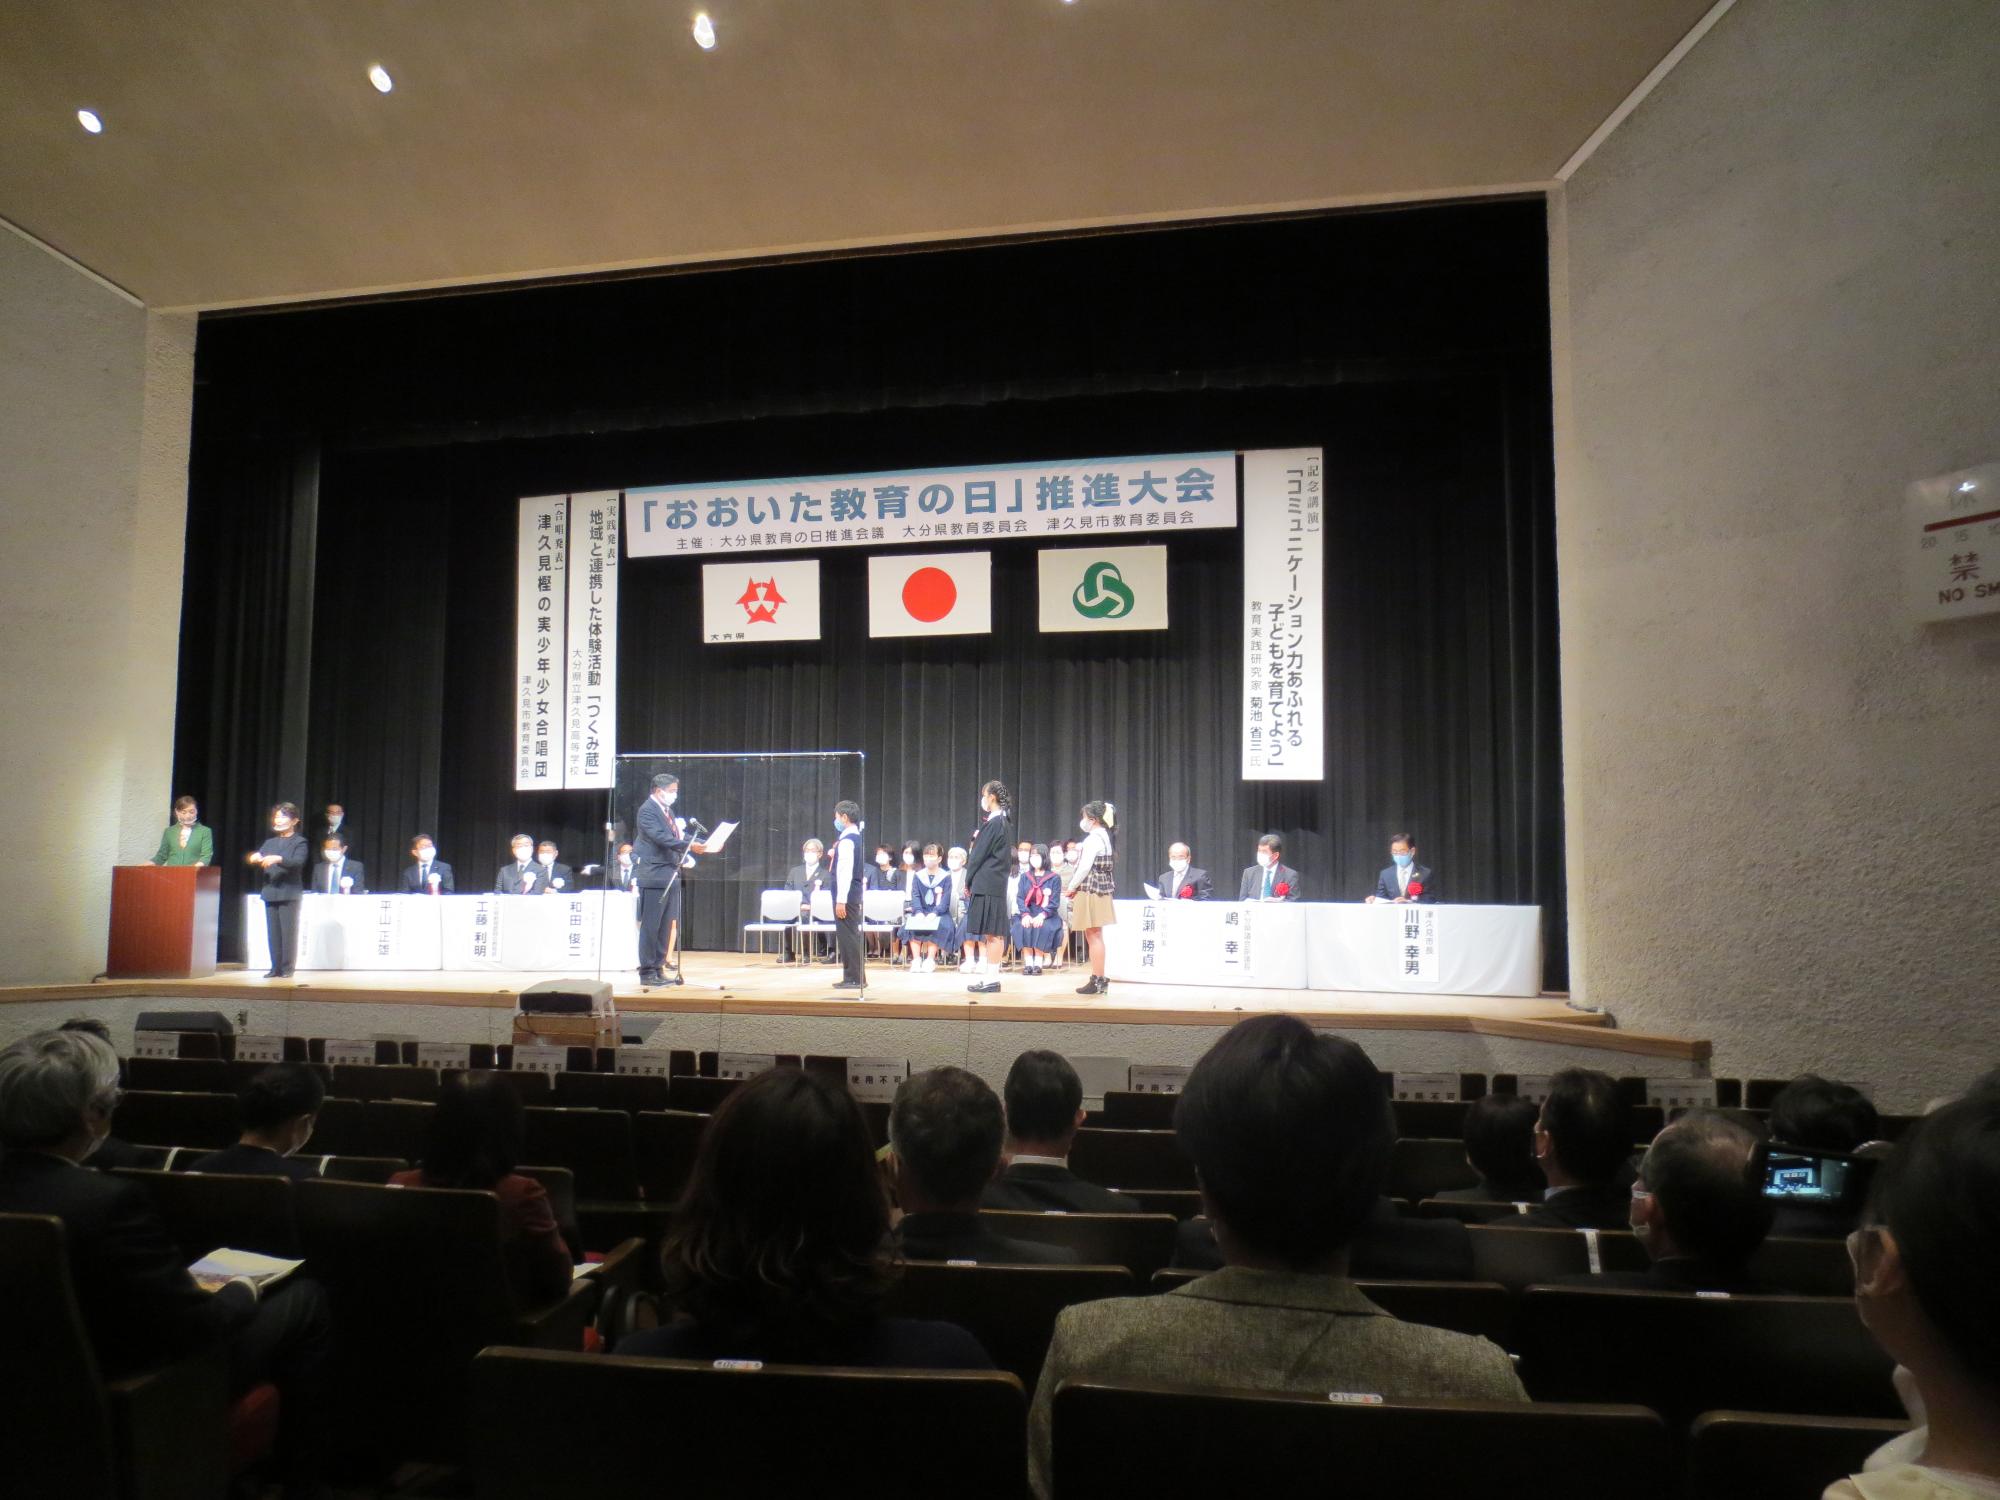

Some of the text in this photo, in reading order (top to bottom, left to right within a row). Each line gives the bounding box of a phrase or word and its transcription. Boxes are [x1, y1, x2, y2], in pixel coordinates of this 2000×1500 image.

[643, 467, 1216, 532] 「おおいた教育の日」推進大会
[902, 518, 1028, 539] 大分県教育委員会
[1046, 510, 1195, 531] 津久見市教育委員会
[1949, 551, 1979, 583] 禁
[1286, 469, 1304, 747] 「コミュニケーション力あふれる
[1938, 587, 1964, 605] NO
[534, 514, 552, 778] 津久見樫の実少年少女合唱団
[585, 509, 604, 775] 地域と連携した体験活動「つくみ蔵」
[1267, 603, 1286, 766] 子どもを育てよう」
[379, 900, 392, 925] 平山
[1142, 905, 1156, 932] 広瀬
[474, 931, 487, 957] 利明
[568, 901, 582, 957] 和田 俊二
[1404, 909, 1420, 975] 川野 幸男
[851, 1075, 904, 1086] 使用不可
[1135, 1083, 1176, 1092] 使用不
